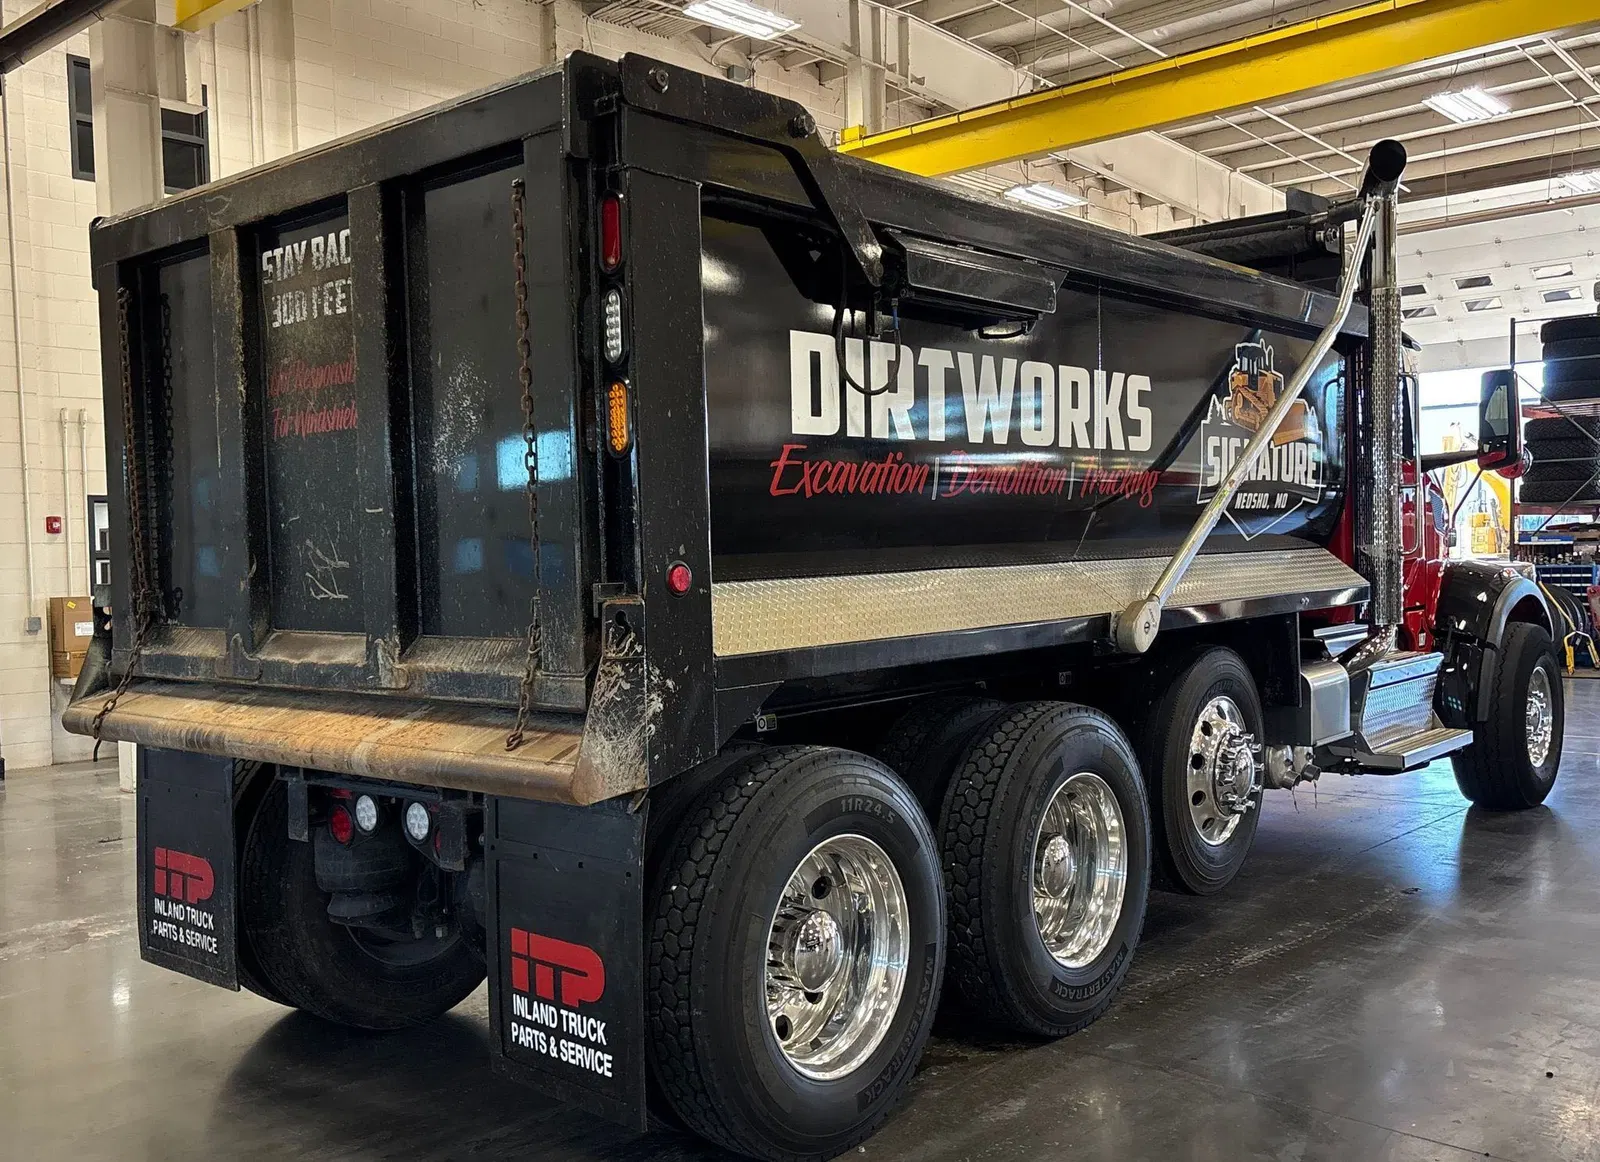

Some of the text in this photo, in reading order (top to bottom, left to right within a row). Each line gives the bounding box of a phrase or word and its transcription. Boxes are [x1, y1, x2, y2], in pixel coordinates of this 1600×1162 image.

[262, 228, 351, 284] STAY BAC
[271, 277, 353, 328] 300 FEE
[789, 329, 1153, 452] DIRTWORKS
[769, 444, 929, 498] Excavation
[941, 449, 1069, 498] Demolition
[1080, 455, 1162, 507] Trucking
[1274, 493, 1289, 509] MO
[841, 797, 896, 824] 11R24.5
[153, 920, 218, 954] PARTS & SERVICE
[154, 898, 215, 931] INLAND TRUCK
[1054, 952, 1124, 1000] MASTERTRACK
[513, 993, 607, 1046] INLAND TRUCK
[511, 1022, 613, 1078] PARTS & SERVICE
